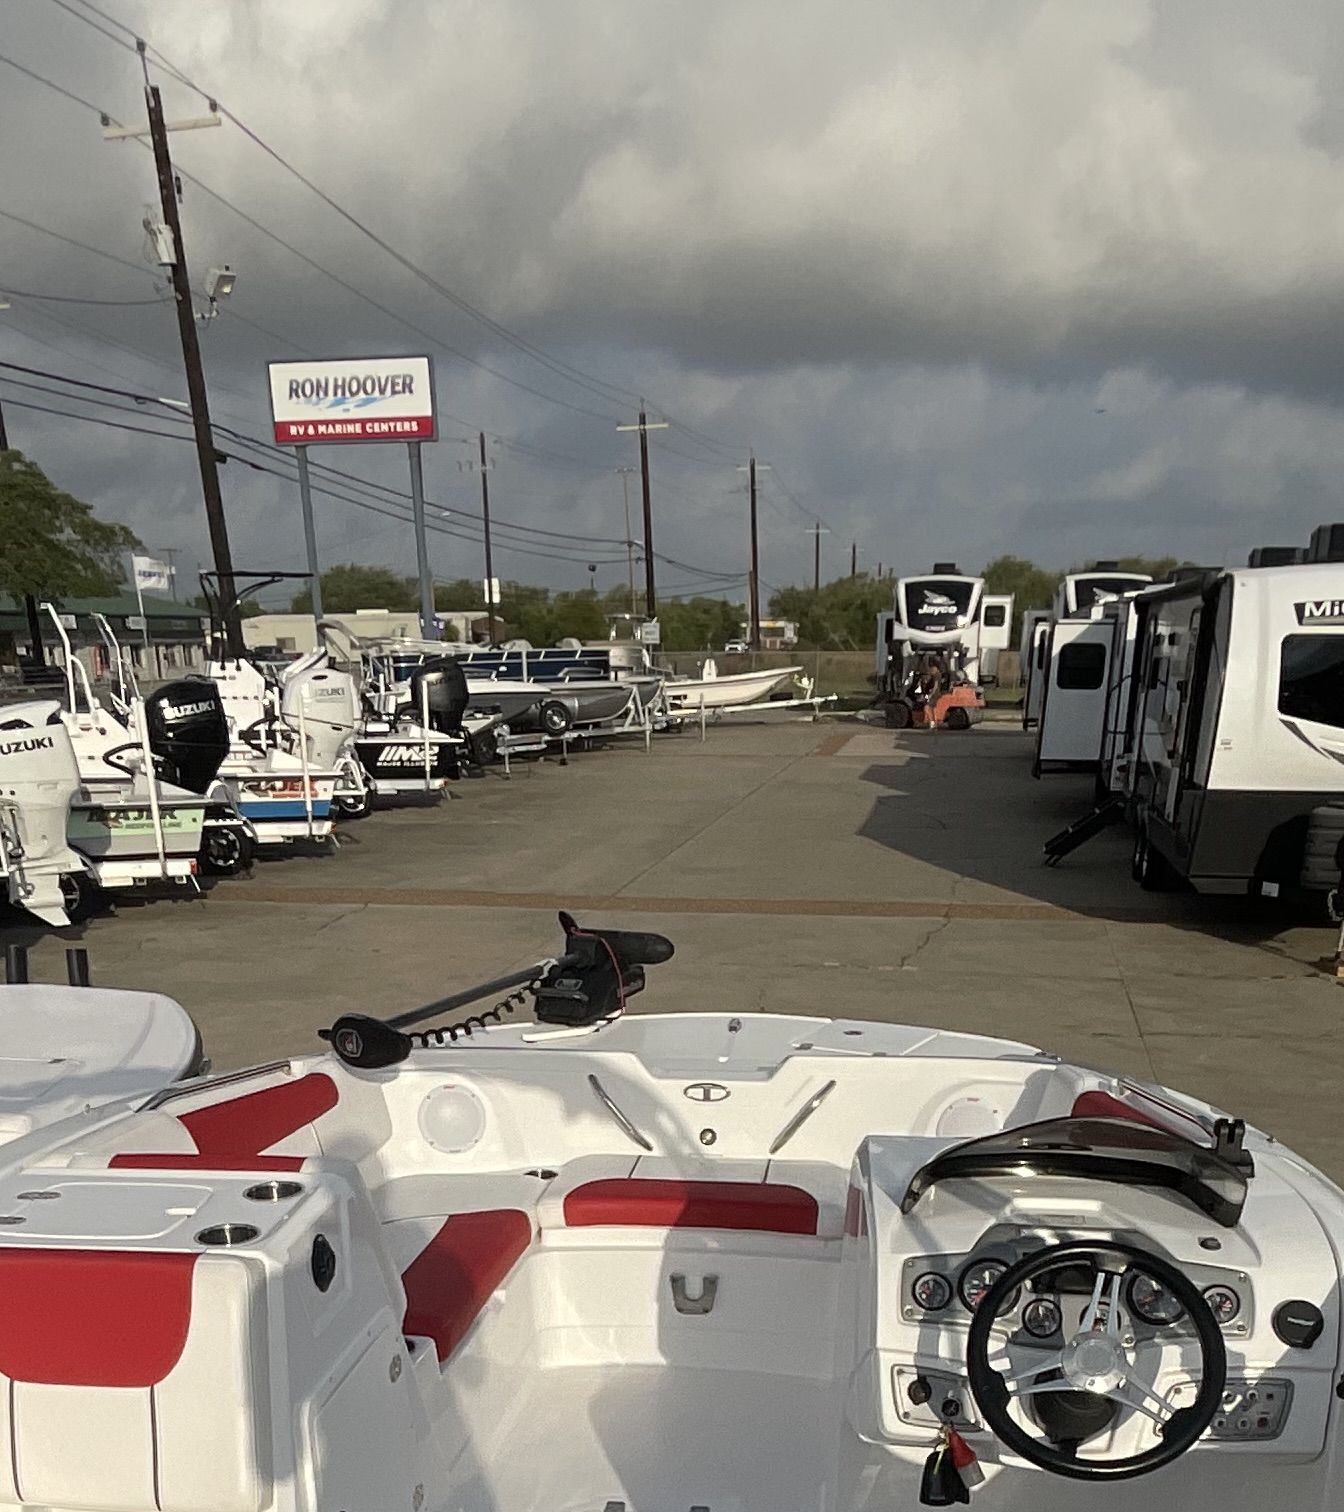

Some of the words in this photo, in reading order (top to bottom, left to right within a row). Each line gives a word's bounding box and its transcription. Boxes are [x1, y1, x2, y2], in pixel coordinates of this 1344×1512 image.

[289, 378, 329, 400] RON
[333, 374, 414, 398] HOOVER
[289, 425, 304, 436] RV
[307, 424, 315, 435] &
[318, 423, 362, 434] MARINE
[365, 421, 419, 433] CENTERS
[917, 603, 958, 616] Jayco
